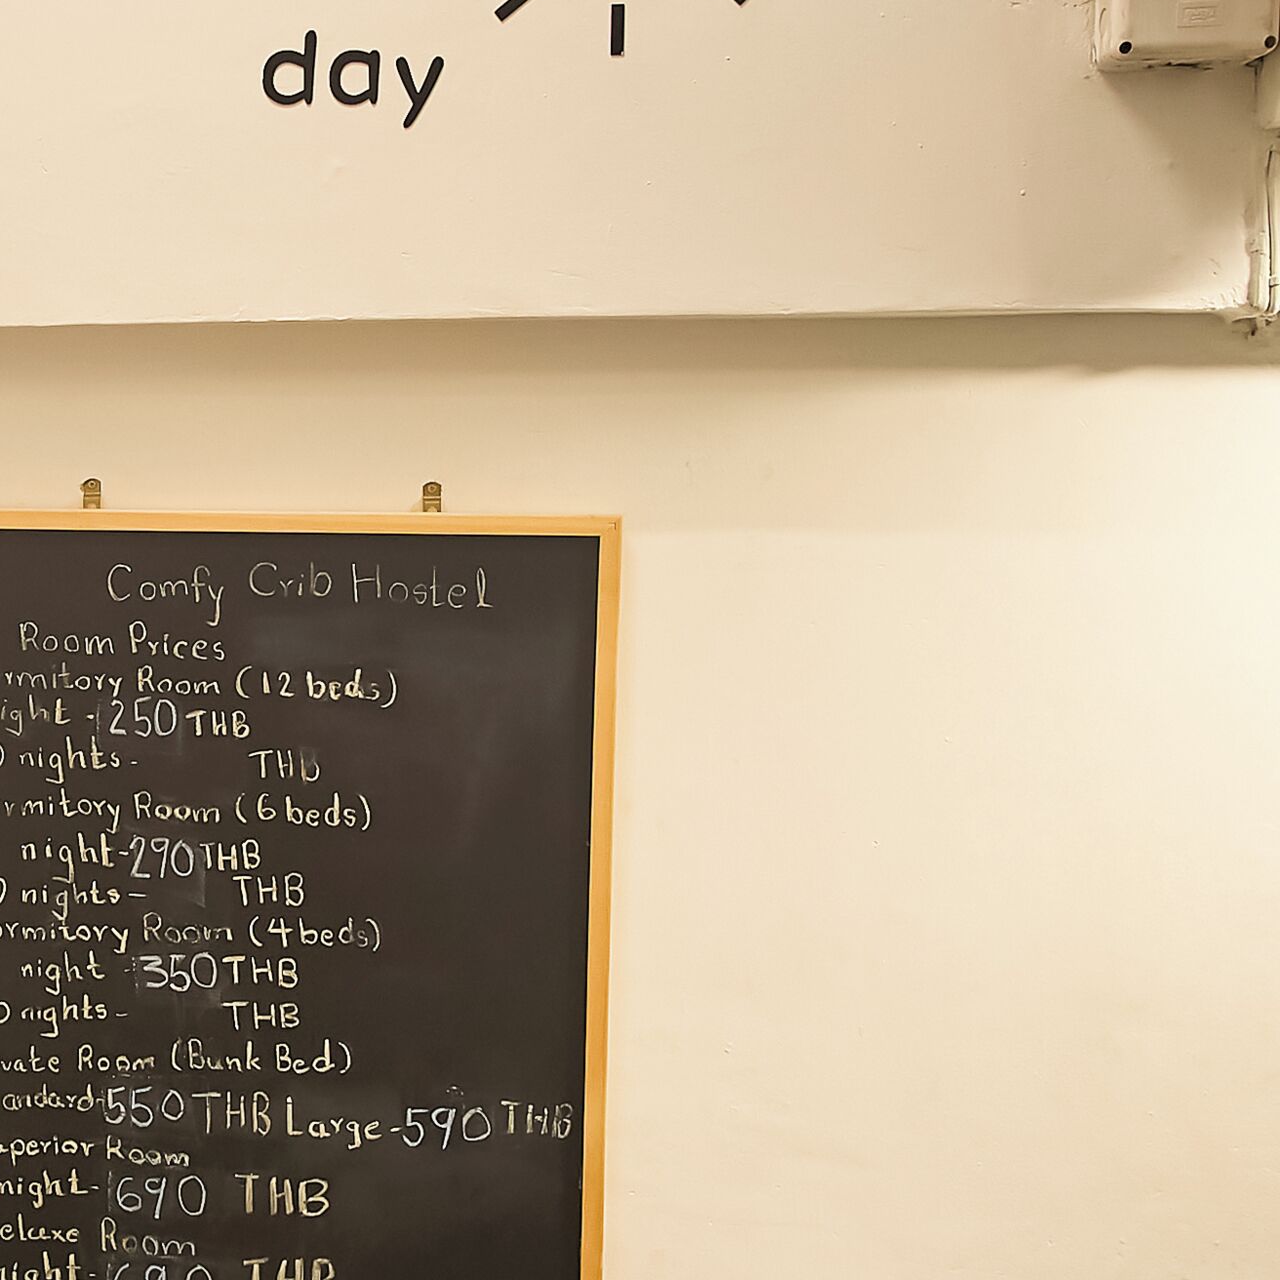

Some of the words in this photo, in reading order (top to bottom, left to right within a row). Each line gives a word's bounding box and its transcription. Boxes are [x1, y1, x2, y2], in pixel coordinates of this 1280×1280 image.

[261, 29, 445, 129] day
[107, 563, 225, 626] Comfy
[248, 561, 332, 598] Crib
[351, 562, 493, 609] Hostel
[20, 622, 114, 655] Room
[129, 621, 226, 661] Prices
[137, 665, 220, 695] Room
[185, 710, 251, 740] THB
[134, 791, 221, 824] Room
[232, 873, 305, 907] THB
[143, 912, 233, 944] Room
[221, 1000, 300, 1031] THB
[77, 1044, 156, 1073] Room
[171, 1037, 263, 1073] (Bunk
[276, 1037, 353, 1075] Bed)
[192, 1090, 272, 1136] THB
[500, 1099, 574, 1139] THB
[106, 1135, 190, 1167] Room
[115, 1174, 207, 1219] 690
[235, 1172, 330, 1218] THB
[100, 1217, 196, 1257] Room
